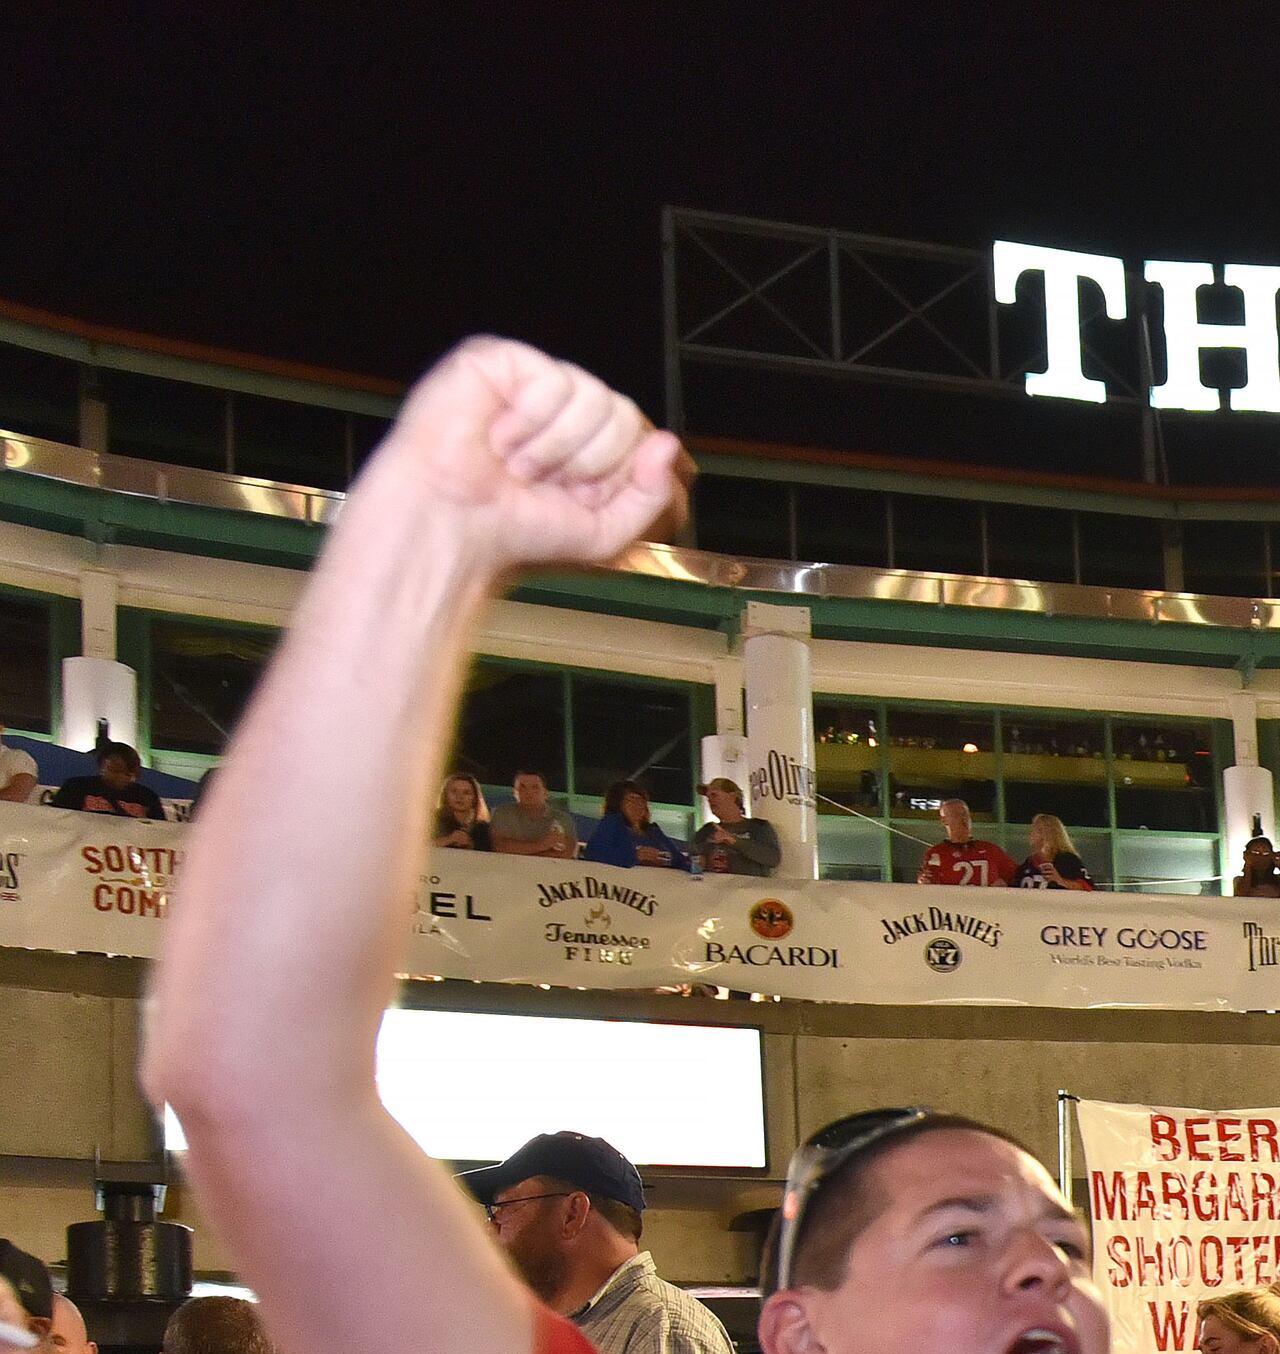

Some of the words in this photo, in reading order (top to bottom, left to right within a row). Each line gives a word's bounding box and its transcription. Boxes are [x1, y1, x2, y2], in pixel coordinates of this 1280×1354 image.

[93, 884, 171, 919] COM
[537, 879, 585, 908] JACK
[585, 876, 660, 917] DANIEL'S
[545, 923, 651, 950] Tennessee
[881, 912, 927, 946] JACK
[928, 906, 1003, 948] DANIEL'S
[1040, 925, 1108, 948] GREY
[1117, 927, 1208, 950] GOOSE
[704, 943, 840, 969] BACARDI
[1149, 1113, 1280, 1164] BEER
